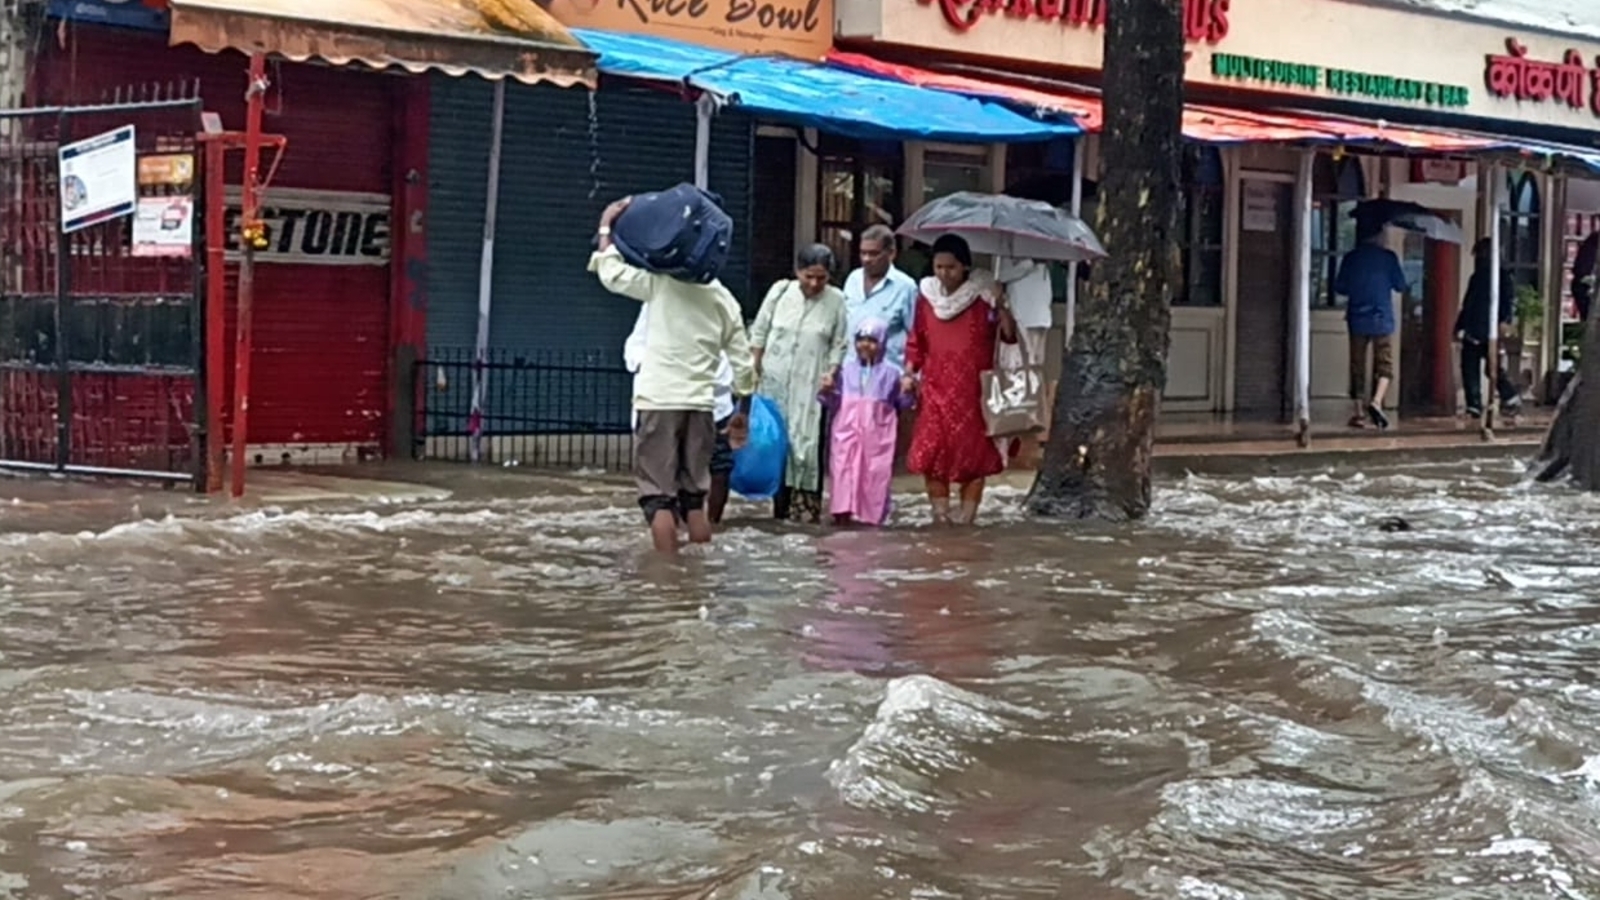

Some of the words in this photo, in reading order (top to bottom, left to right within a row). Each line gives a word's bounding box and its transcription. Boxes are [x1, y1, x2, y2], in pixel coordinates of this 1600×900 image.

[725, 0, 819, 32] Bowl
[1211, 53, 1323, 89] MULTICUISINE
[1326, 69, 1422, 100] RESTAURANT
[1440, 85, 1469, 107] BAR
[224, 205, 389, 256] ETONE
